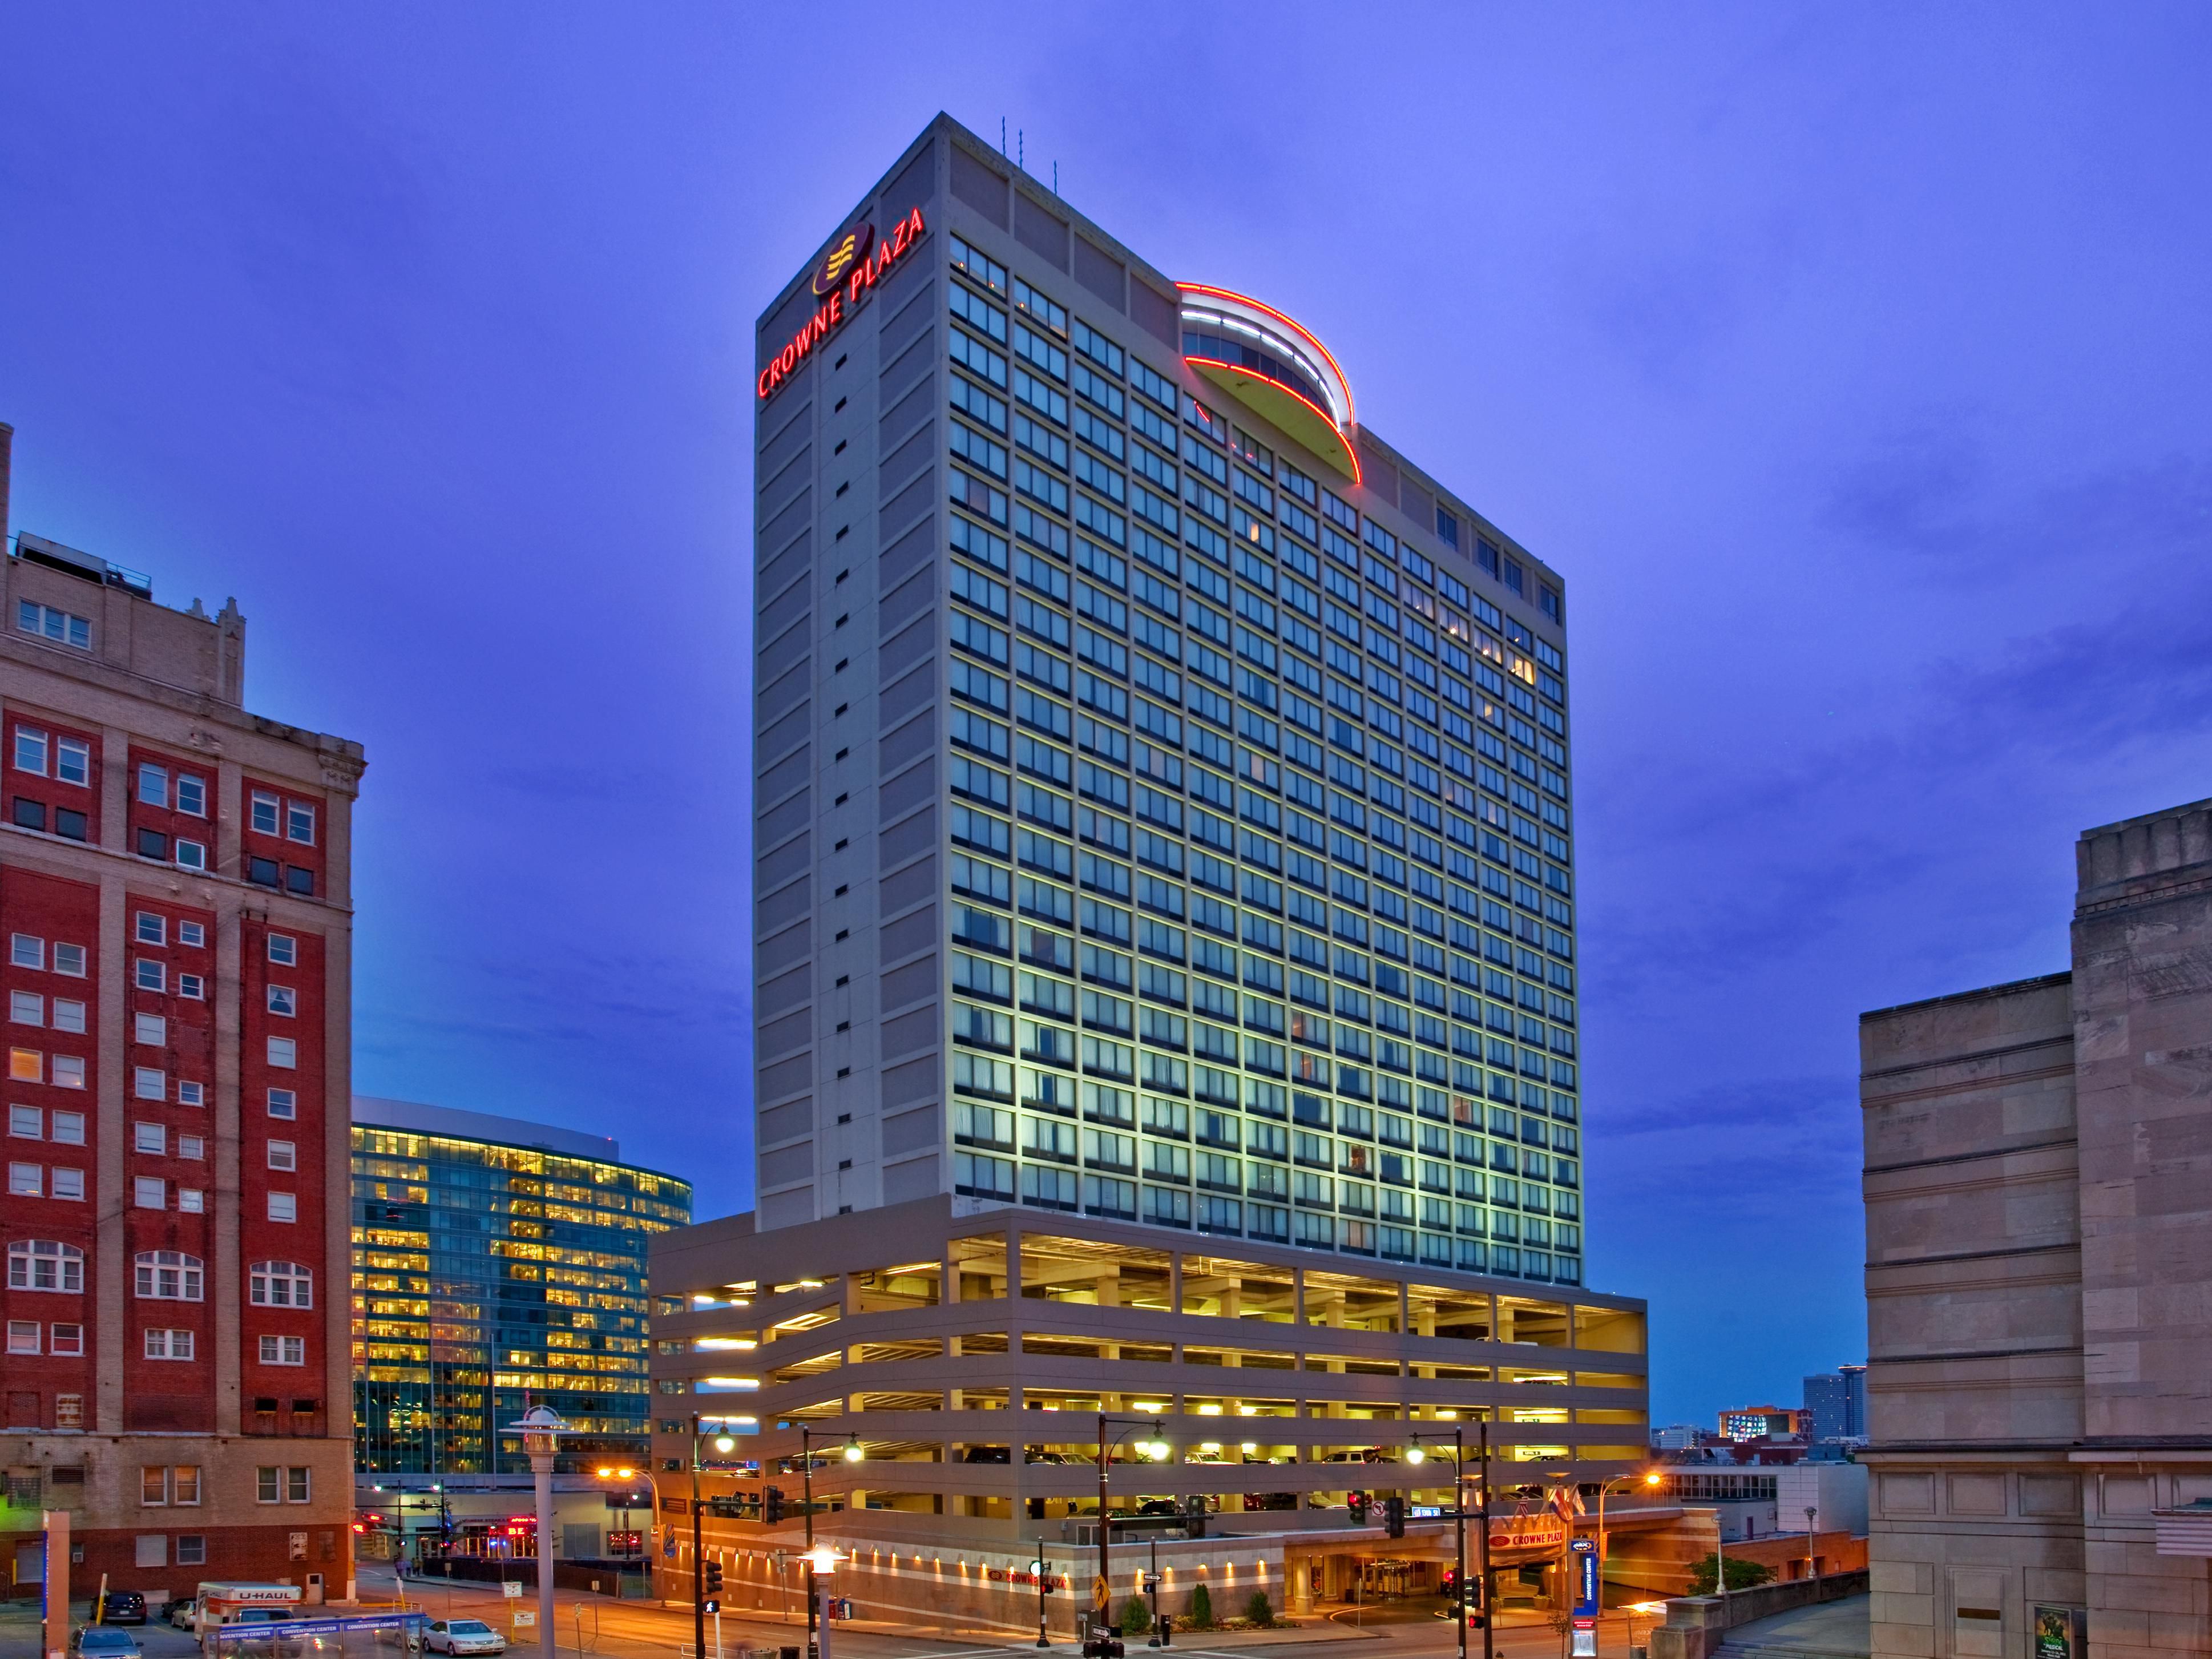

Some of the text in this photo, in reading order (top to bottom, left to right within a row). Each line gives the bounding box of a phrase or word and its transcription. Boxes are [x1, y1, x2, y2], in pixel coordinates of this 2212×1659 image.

[757, 207, 924, 399] CROWNE PLAZA
[1513, 1534, 1545, 1545] CROWNE
